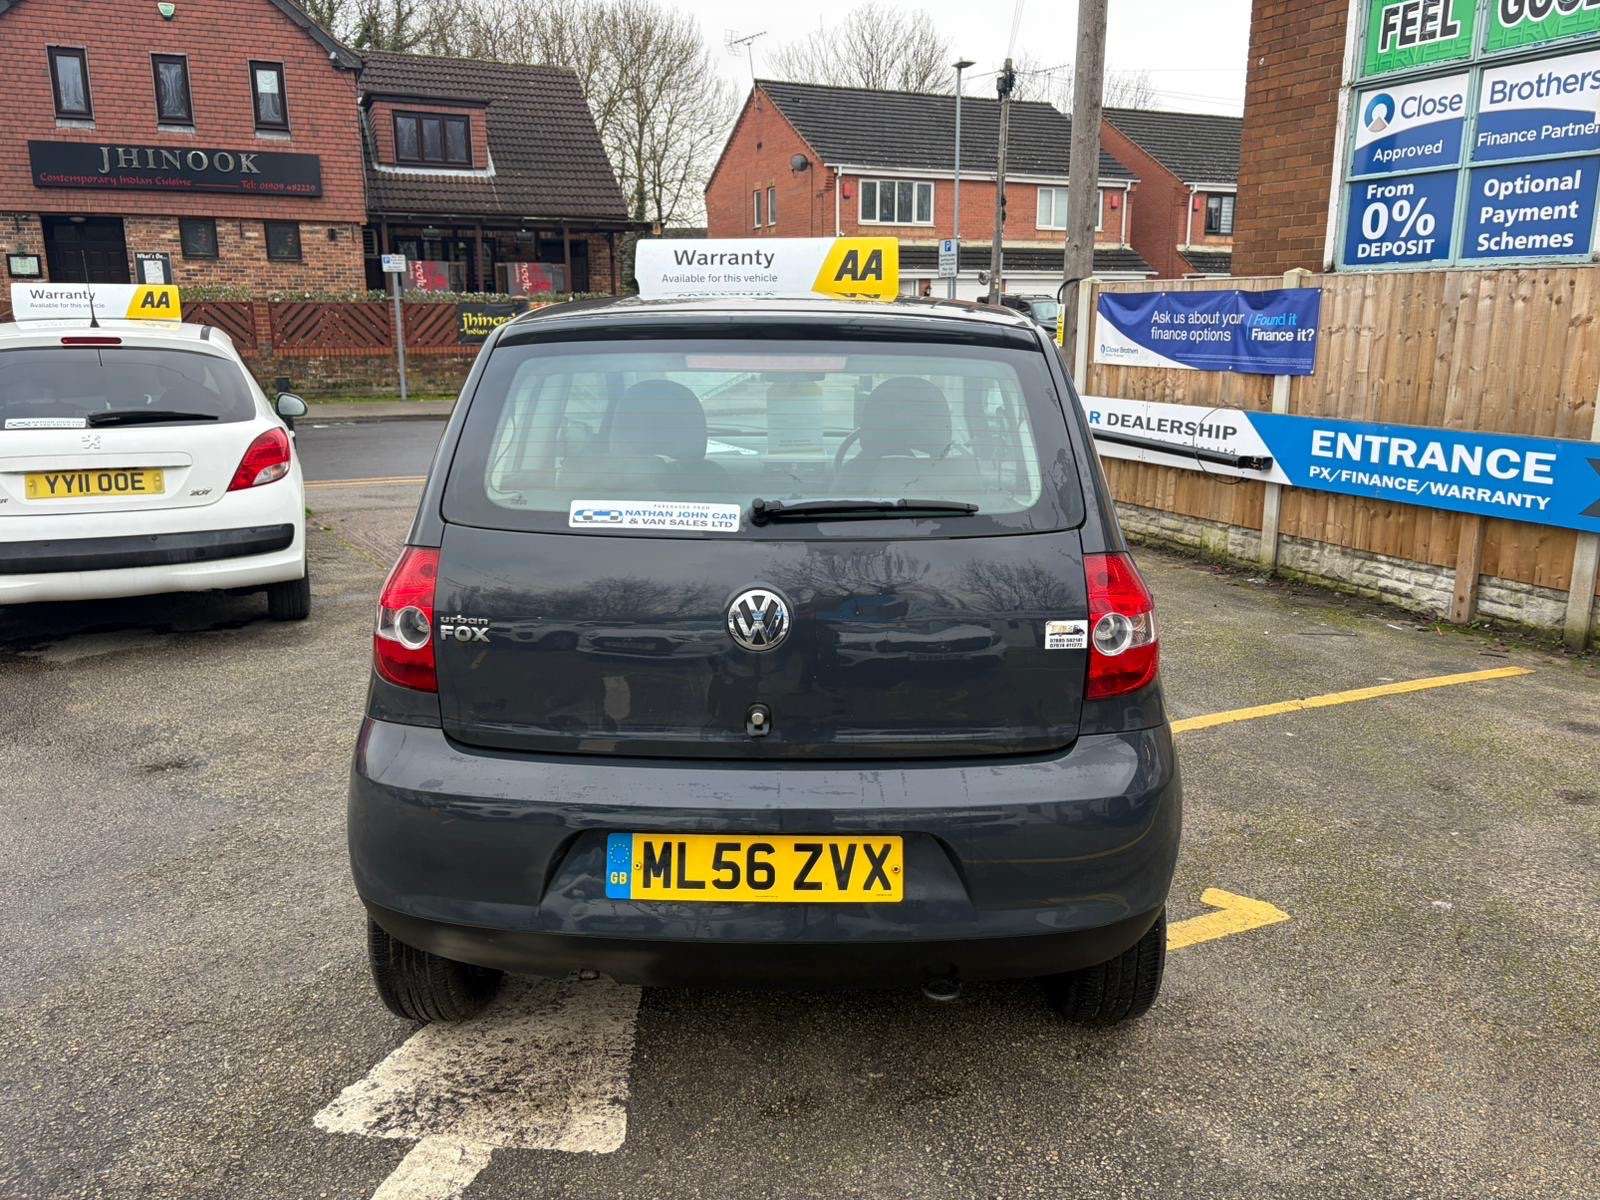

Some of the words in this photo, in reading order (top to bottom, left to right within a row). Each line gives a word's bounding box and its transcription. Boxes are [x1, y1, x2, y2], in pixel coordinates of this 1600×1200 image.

[1379, 0, 1460, 52] FEEL
[1489, 69, 1600, 105] Brothers
[1401, 93, 1464, 119] Close
[1477, 128, 1537, 147] Finance
[98, 146, 261, 174] JHINOOK
[1373, 140, 1443, 163] Approved
[1366, 182, 1415, 199] From
[1484, 169, 1582, 200] Optional
[1362, 197, 1436, 240] 0%
[1480, 201, 1579, 227] Payment
[1357, 239, 1436, 258] DEPOSIT
[1477, 232, 1574, 251] Schemes
[674, 248, 776, 269] Warranty
[833, 249, 884, 282] AA
[661, 273, 709, 283] Available
[710, 272, 722, 283] for
[723, 272, 742, 283] this
[744, 273, 779, 283] vehicle
[30, 289, 95, 301] Warranty
[141, 291, 170, 309] AA
[1151, 310, 1171, 325] Ask
[1173, 314, 1185, 325] us
[1188, 311, 1220, 325] about
[1253, 313, 1286, 326] Found
[1288, 313, 1297, 325] it
[1151, 328, 1187, 341] finance
[1189, 328, 1231, 344] options
[1251, 328, 1294, 341] Finance
[1297, 328, 1315, 341] it?
[1106, 412, 1238, 441] DEALERSHIP
[1311, 429, 1557, 485] ENTRANCE
[45, 473, 91, 493] YY11
[1309, 465, 1551, 511] PX/FINANCE/WARRANTY
[625, 509, 673, 518] NATHAN
[676, 511, 708, 519] JOHN
[712, 512, 737, 520] CAR
[642, 518, 666, 526] VAN
[669, 519, 708, 527] SALES
[711, 520, 733, 528] LTD
[440, 614, 489, 625] urban
[440, 624, 490, 642] FOX
[642, 841, 776, 890] ML56
[793, 843, 892, 891] ZVX
[610, 871, 628, 885] GB
